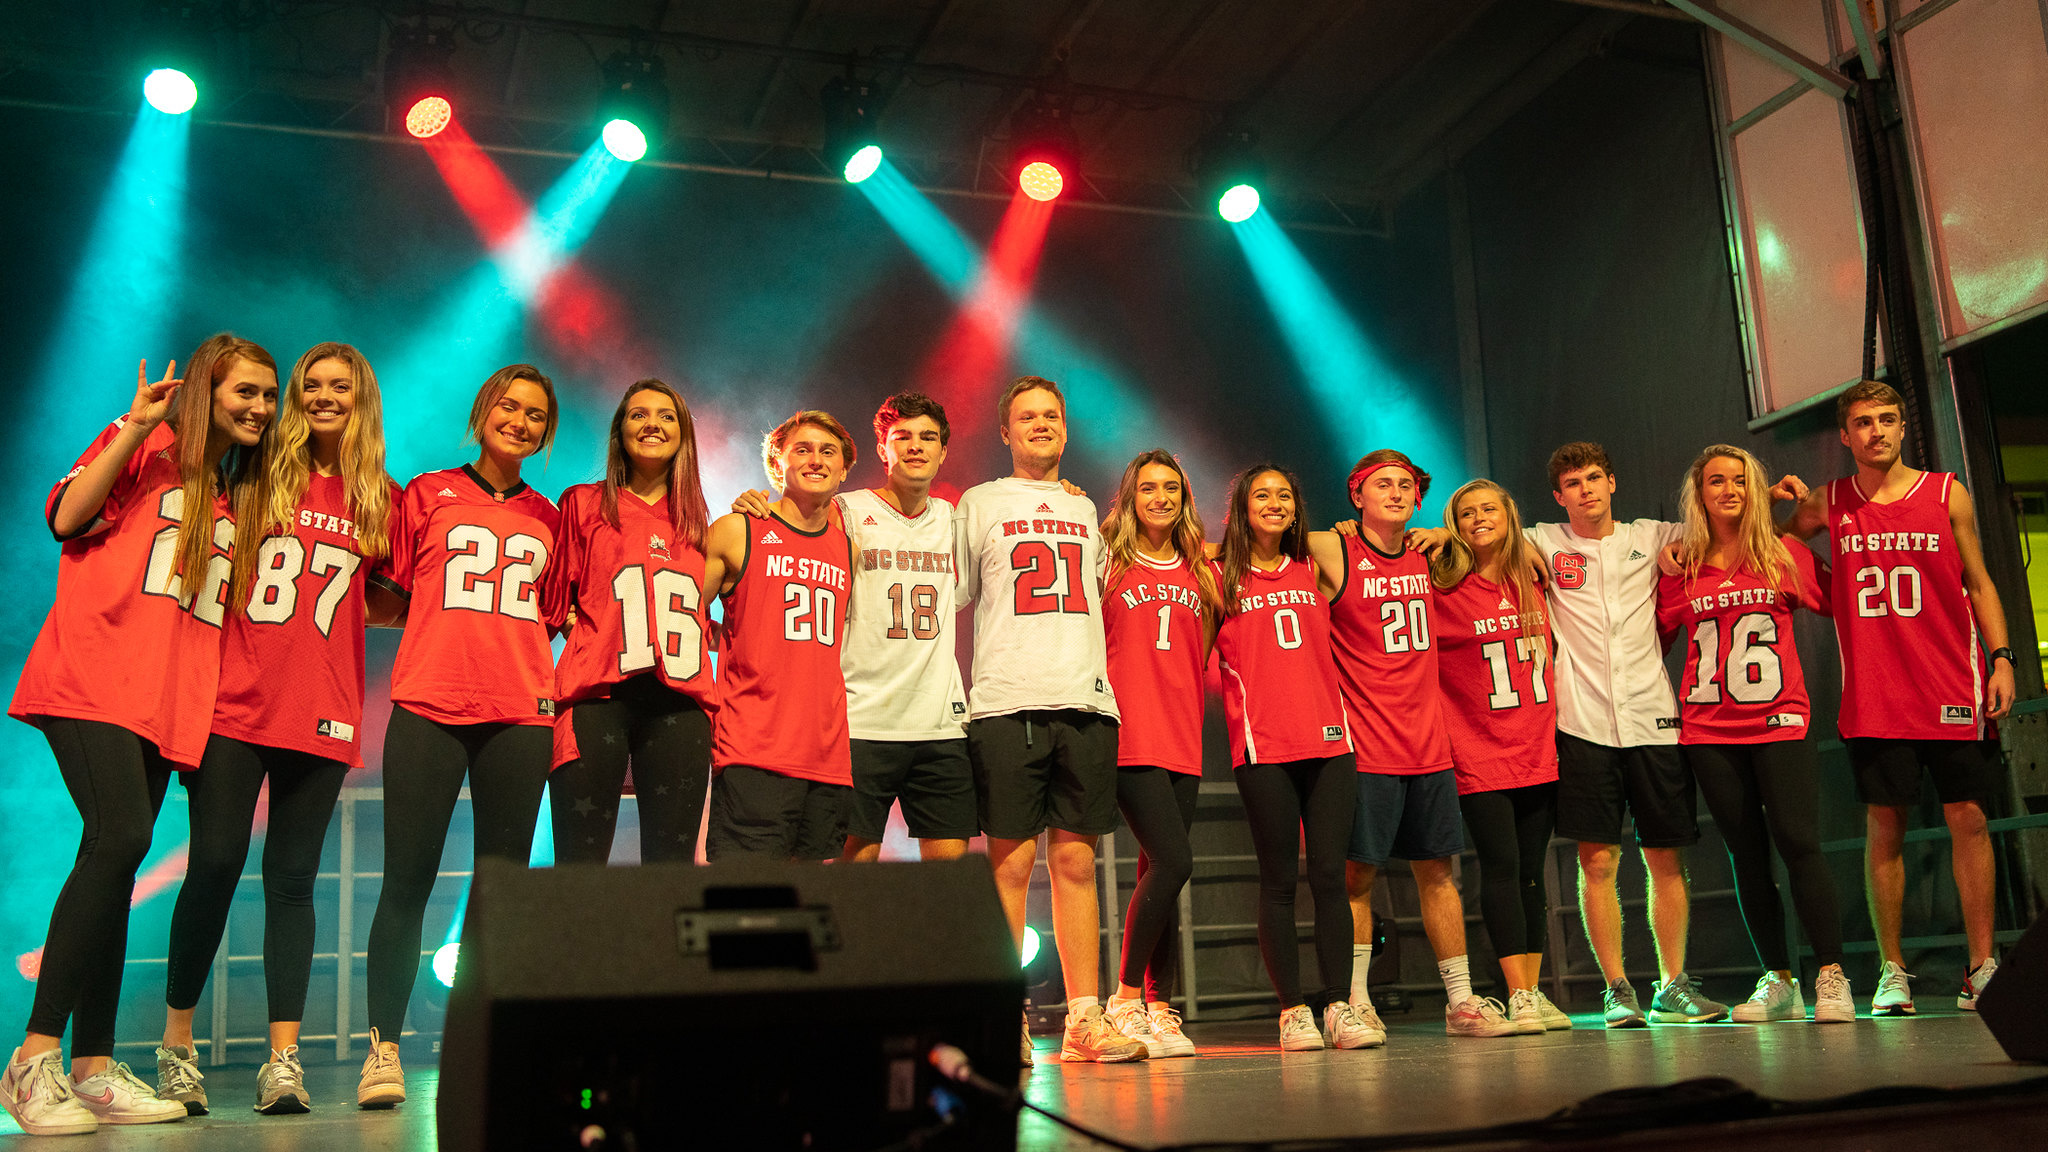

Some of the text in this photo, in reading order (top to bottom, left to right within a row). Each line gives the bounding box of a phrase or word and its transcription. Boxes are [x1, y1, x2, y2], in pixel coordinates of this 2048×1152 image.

[1002, 519, 1089, 539] NC STATE
[1840, 532, 1940, 555] NC STATE
[442, 524, 548, 625] 22
[766, 554, 846, 591] NC STATE
[862, 548, 892, 571] NC
[1010, 541, 1090, 616] 21
[246, 534, 364, 641] 87
[1120, 584, 1156, 610] N.C.
[1240, 590, 1317, 613] NC STATE
[1363, 574, 1430, 598] NC STATE
[1691, 588, 1775, 615] NC STATE
[1856, 565, 1922, 618] 20
[611, 564, 703, 682] 16
[784, 582, 836, 647] 20
[887, 583, 940, 640] 18
[1156, 604, 1171, 651] 1
[1274, 608, 1303, 650] 0
[1380, 598, 1431, 654] 20
[1474, 618, 1498, 636] NC
[1481, 634, 1549, 711] 17
[1685, 611, 1784, 705] 16
